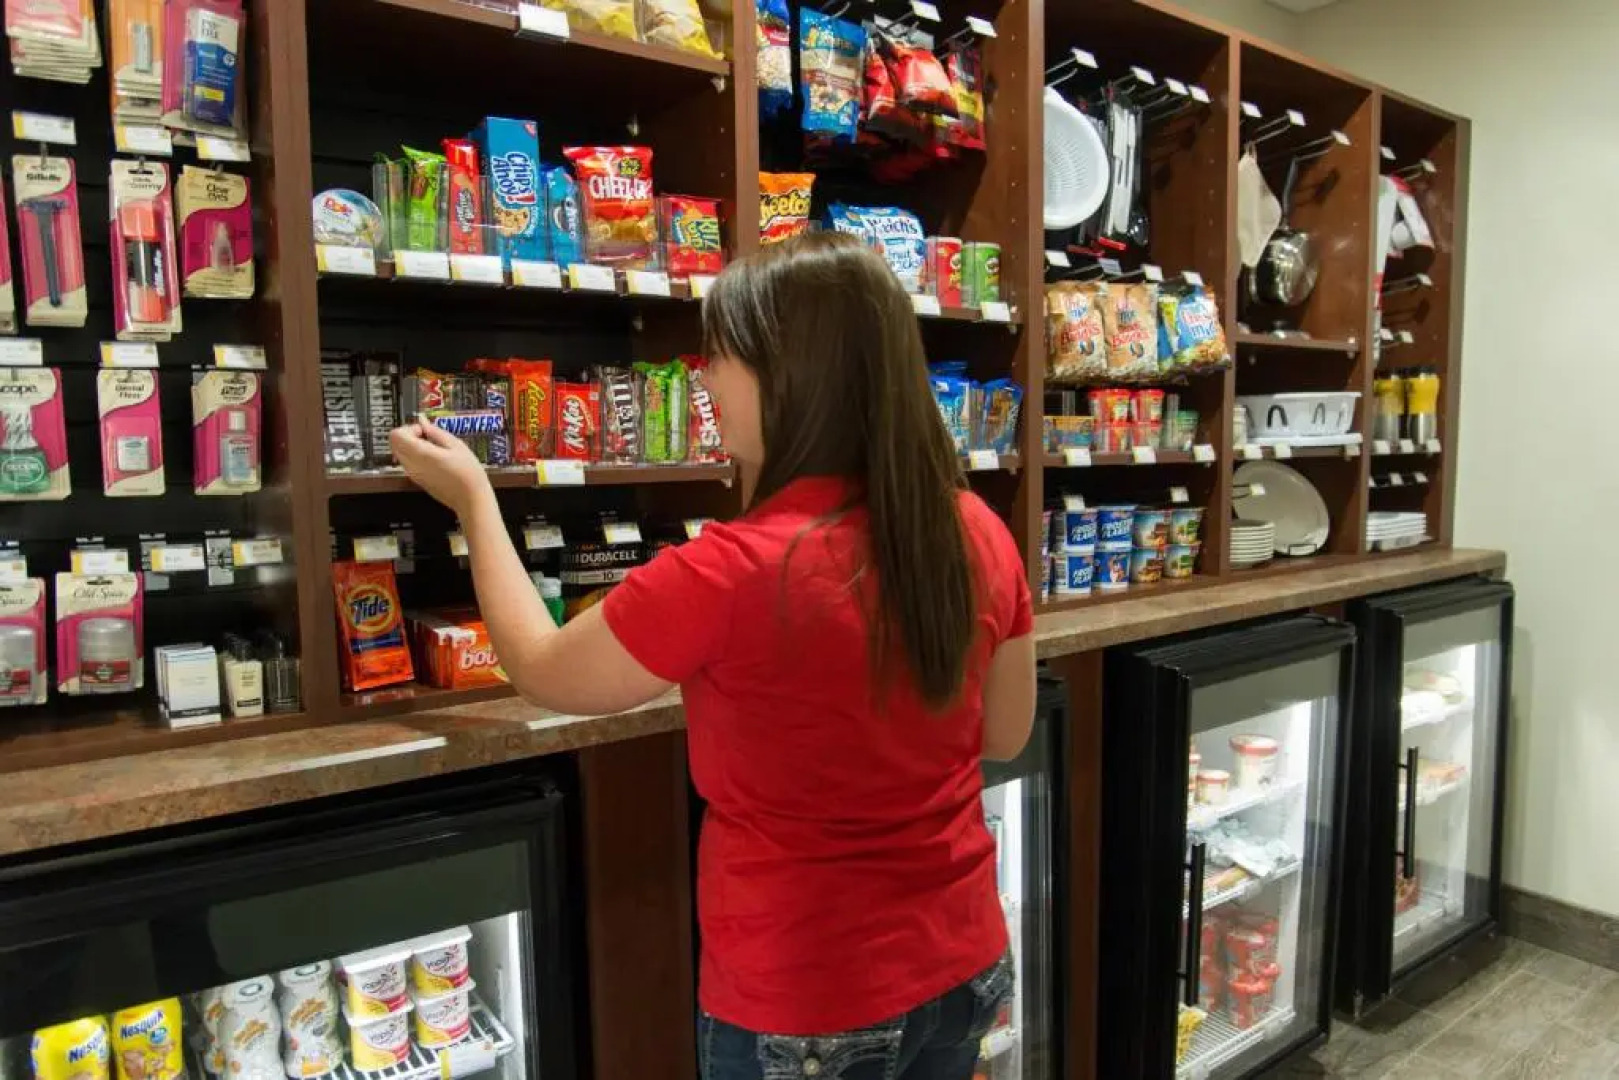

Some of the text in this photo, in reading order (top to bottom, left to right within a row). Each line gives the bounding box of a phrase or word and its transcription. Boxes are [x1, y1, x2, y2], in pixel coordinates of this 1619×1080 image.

[436, 416, 503, 435] SNICKERS
[580, 550, 638, 564] DURACELL
[348, 596, 390, 624] Tide
[460, 648, 498, 671] bou
